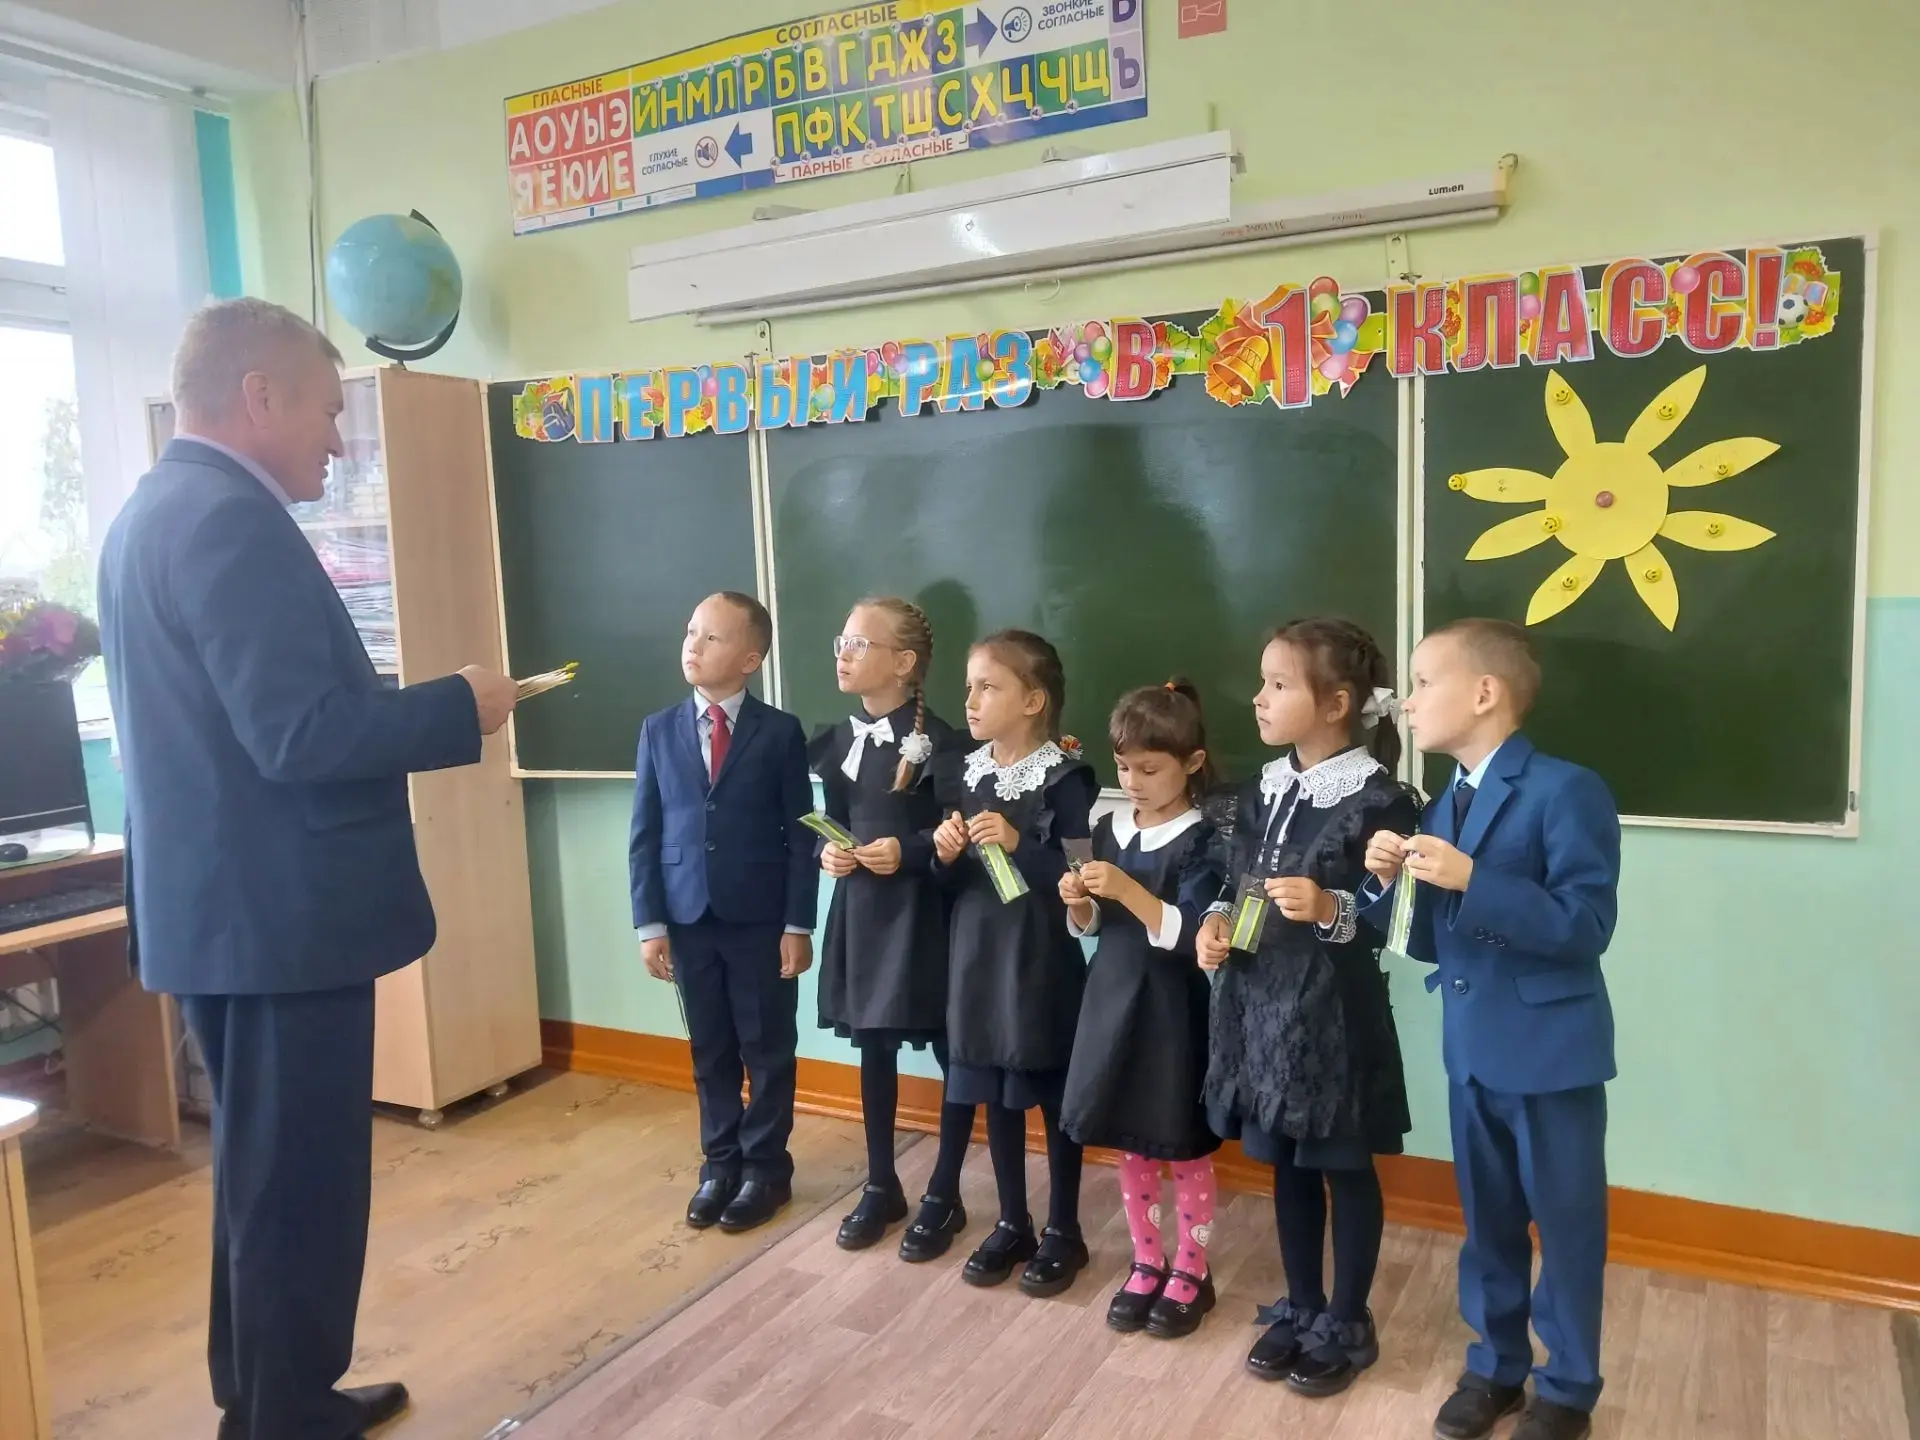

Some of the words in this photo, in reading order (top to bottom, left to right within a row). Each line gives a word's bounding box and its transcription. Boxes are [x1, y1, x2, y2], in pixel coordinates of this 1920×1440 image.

[776, 4, 898, 43] СОГЛАСНЫЕ
[1038, 5, 1104, 30] СОГЛАСНЫЕ
[1113, 46, 1141, 90] Ъ
[532, 78, 604, 108] ГЛАСНЫЕ
[641, 156, 688, 175] СОГЛАСНЫЕ
[649, 147, 678, 162] ГЛУХИЕ
[791, 156, 853, 179] ПАРНЫЕ
[861, 137, 953, 166] СОГЛАСНЫЕ
[573, 347, 869, 444] ПЕРВЫЙ
[898, 330, 1033, 416] РАЗ
[1107, 316, 1159, 402] В
[1254, 282, 1315, 410] 1
[1386, 247, 1787, 379] КЛАСС!
